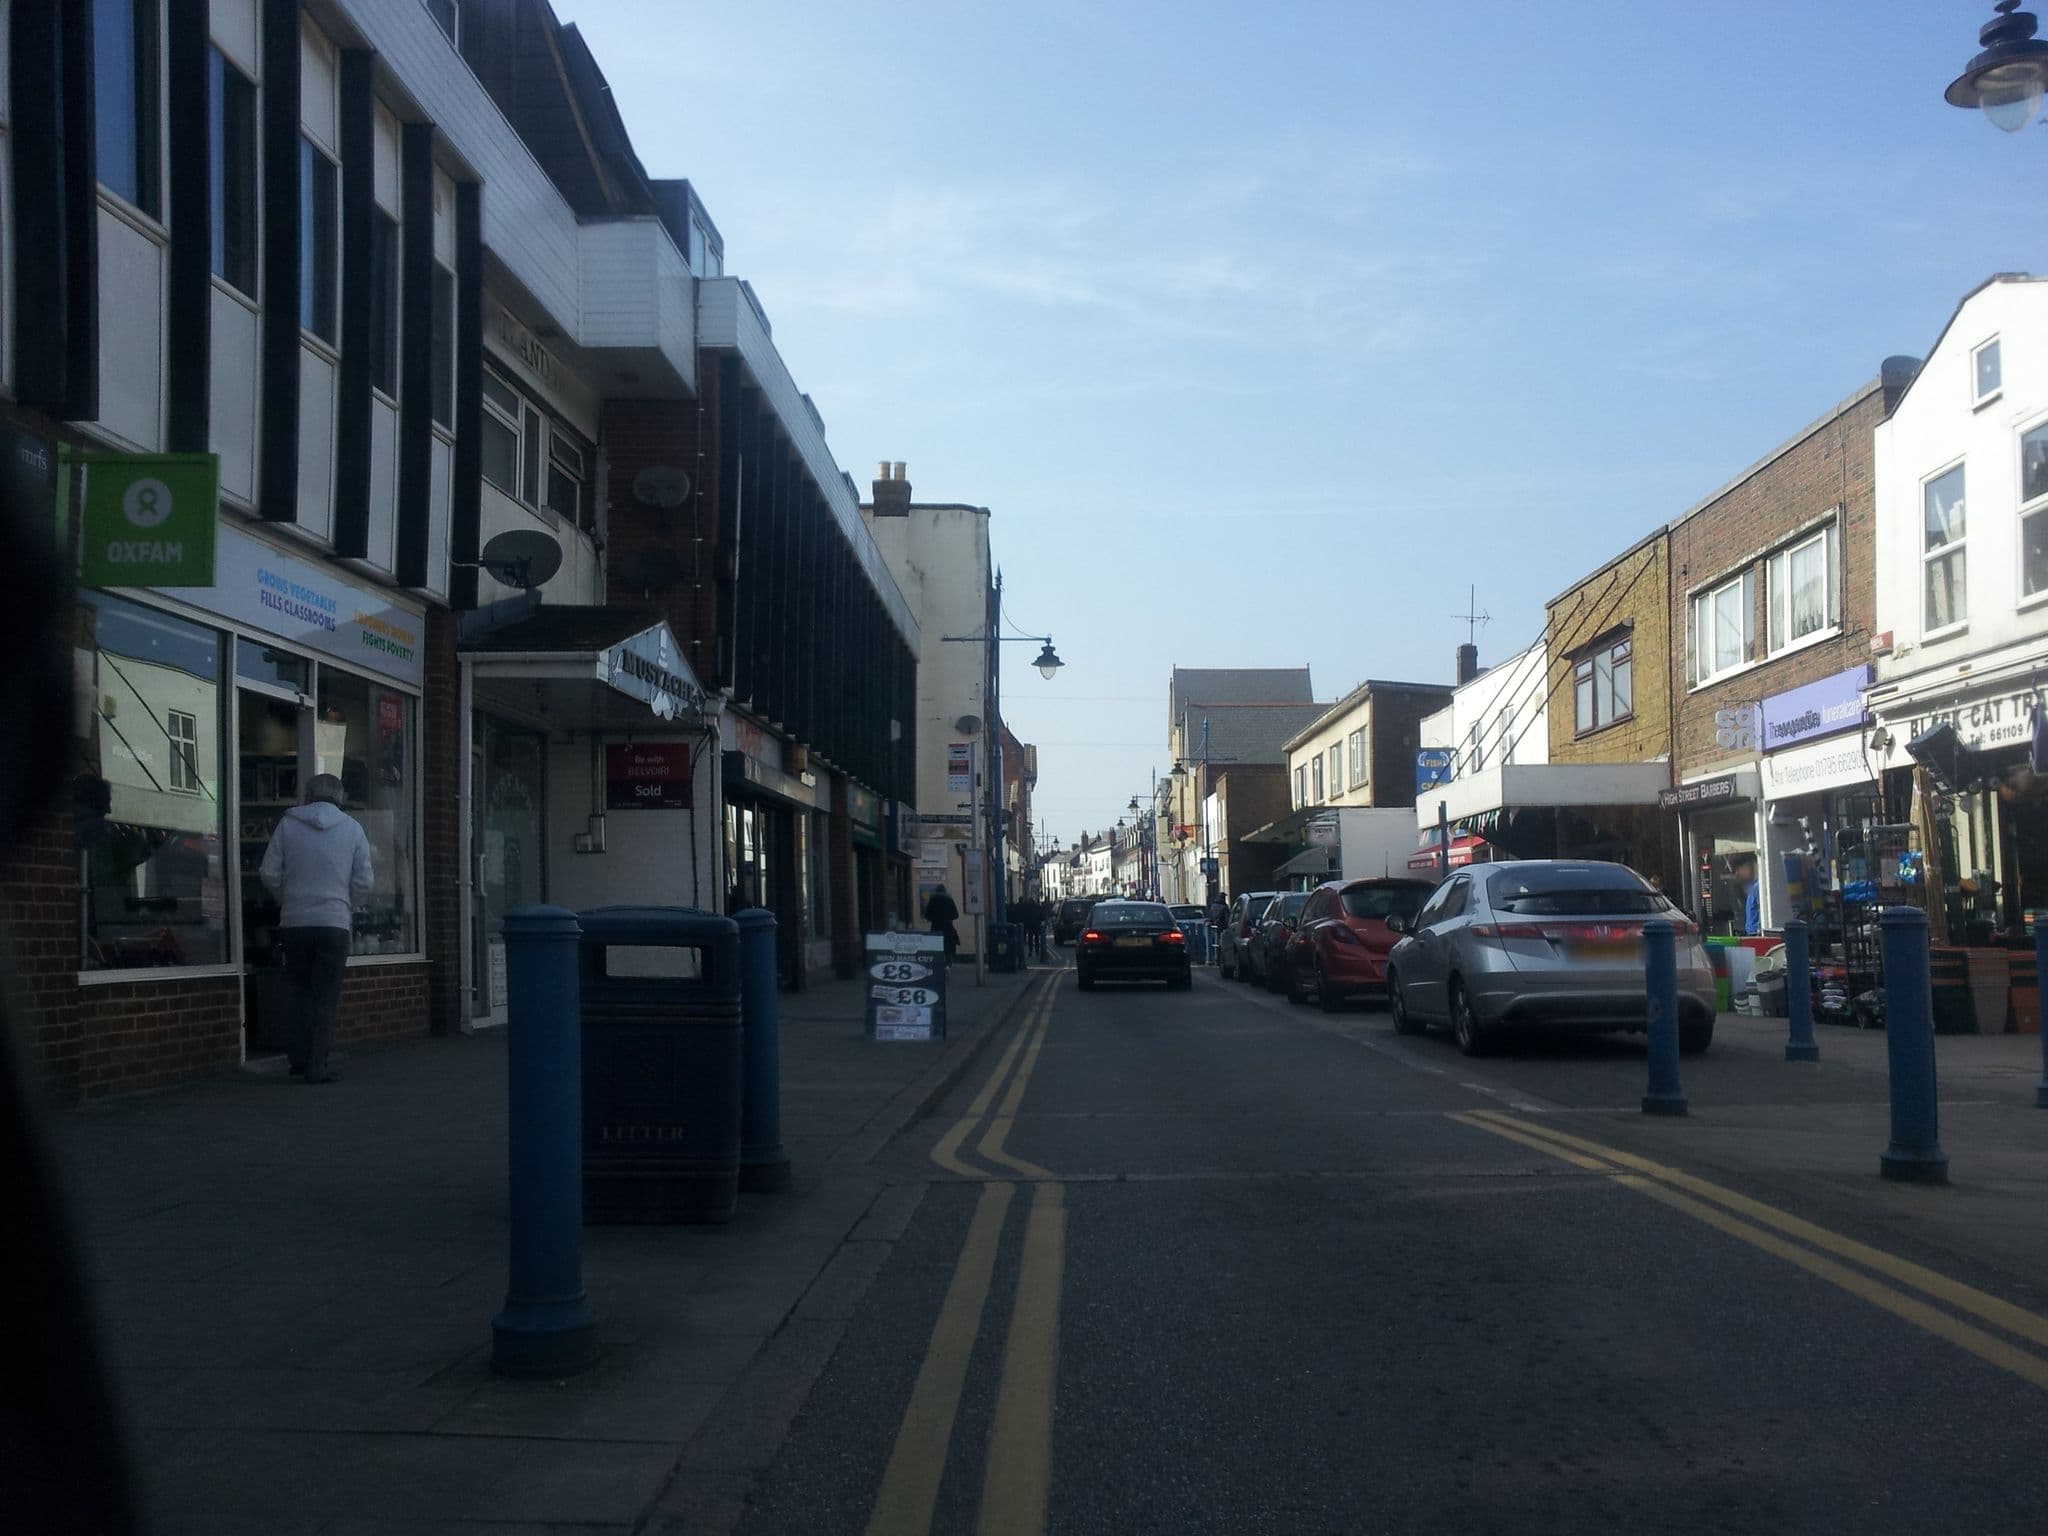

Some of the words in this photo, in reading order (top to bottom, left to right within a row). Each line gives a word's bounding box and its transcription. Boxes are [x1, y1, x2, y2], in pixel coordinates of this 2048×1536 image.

[106, 541, 182, 563] OXFAM
[261, 589, 281, 611] FILLS
[284, 601, 336, 632] CLASSROOMS
[362, 630, 385, 651] FIGHTS
[387, 638, 414, 663] POVERTY
[1970, 698, 2003, 728] CAT
[1990, 724, 2023, 742] 661109
[635, 784, 662, 797] Sold
[1664, 793, 1679, 805] HIGH
[1679, 787, 1699, 803] STREET
[1701, 780, 1730, 799] BARBERS
[882, 964, 912, 980] £8
[898, 989, 926, 1005] £6
